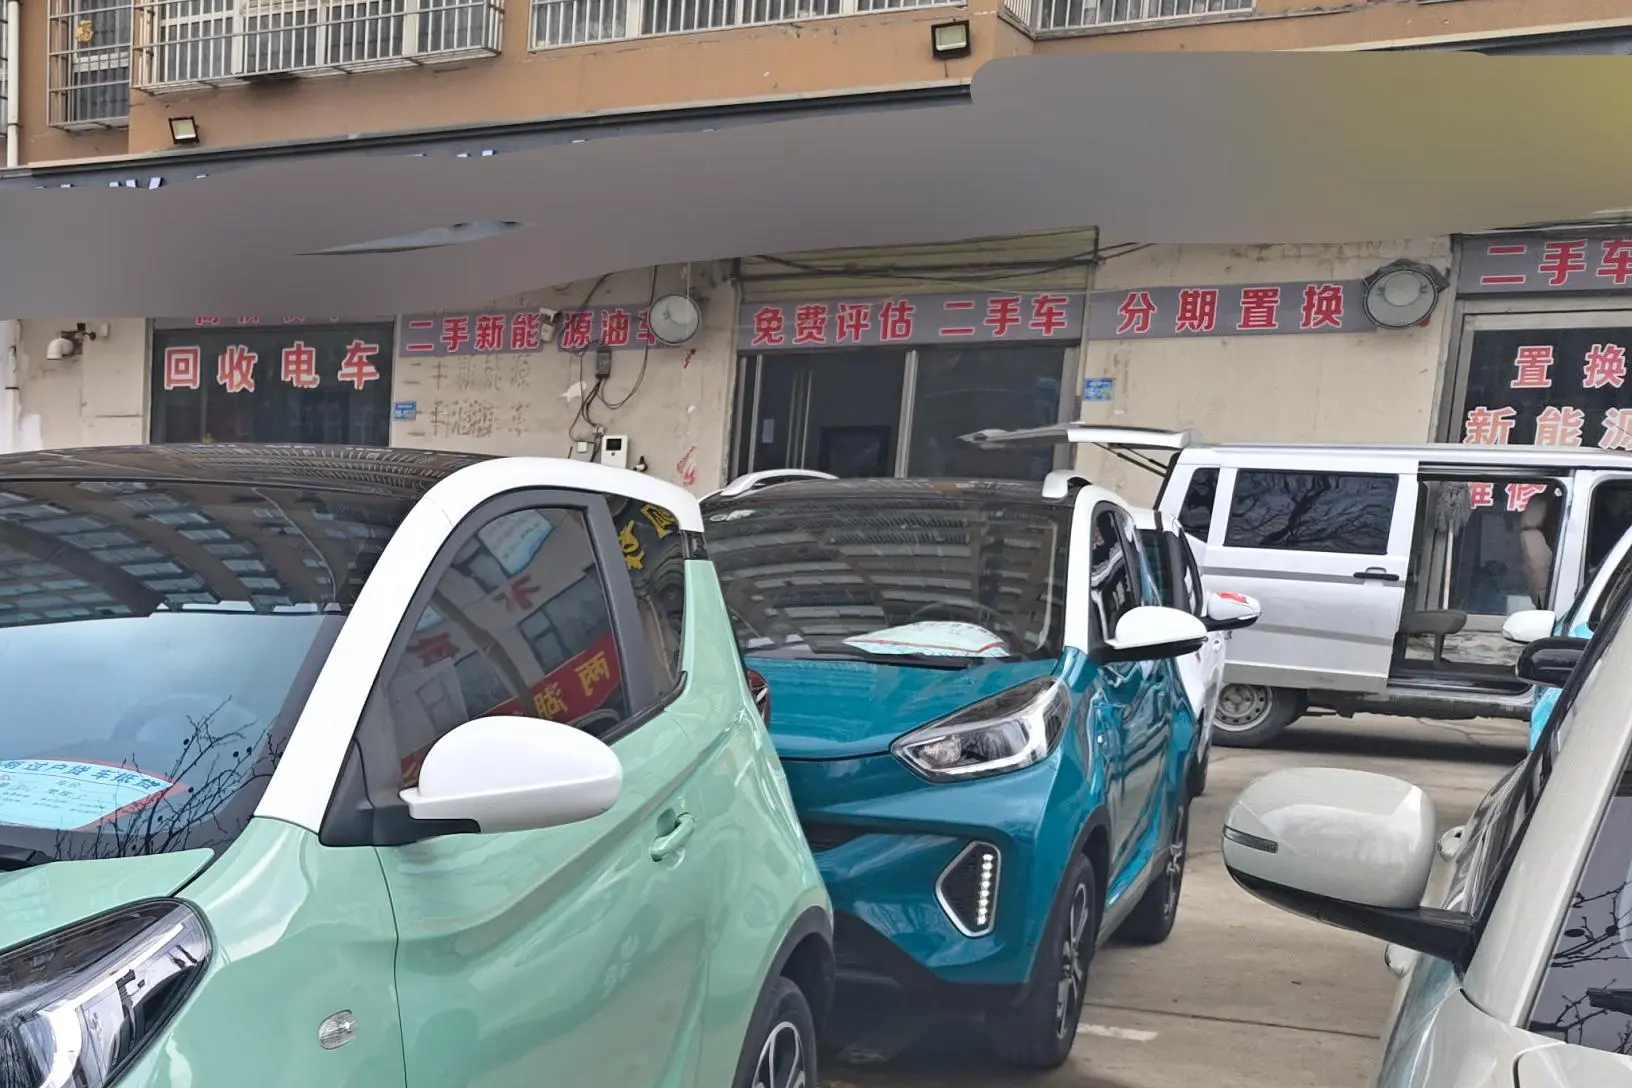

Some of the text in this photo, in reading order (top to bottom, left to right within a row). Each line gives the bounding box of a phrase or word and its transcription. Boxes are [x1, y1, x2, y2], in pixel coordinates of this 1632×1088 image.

[752, 294, 1068, 346] 免费评估 二手车
[1116, 284, 1344, 334] 分期置换
[164, 340, 380, 393] 回收电车
[1510, 343, 1627, 389] 置换
